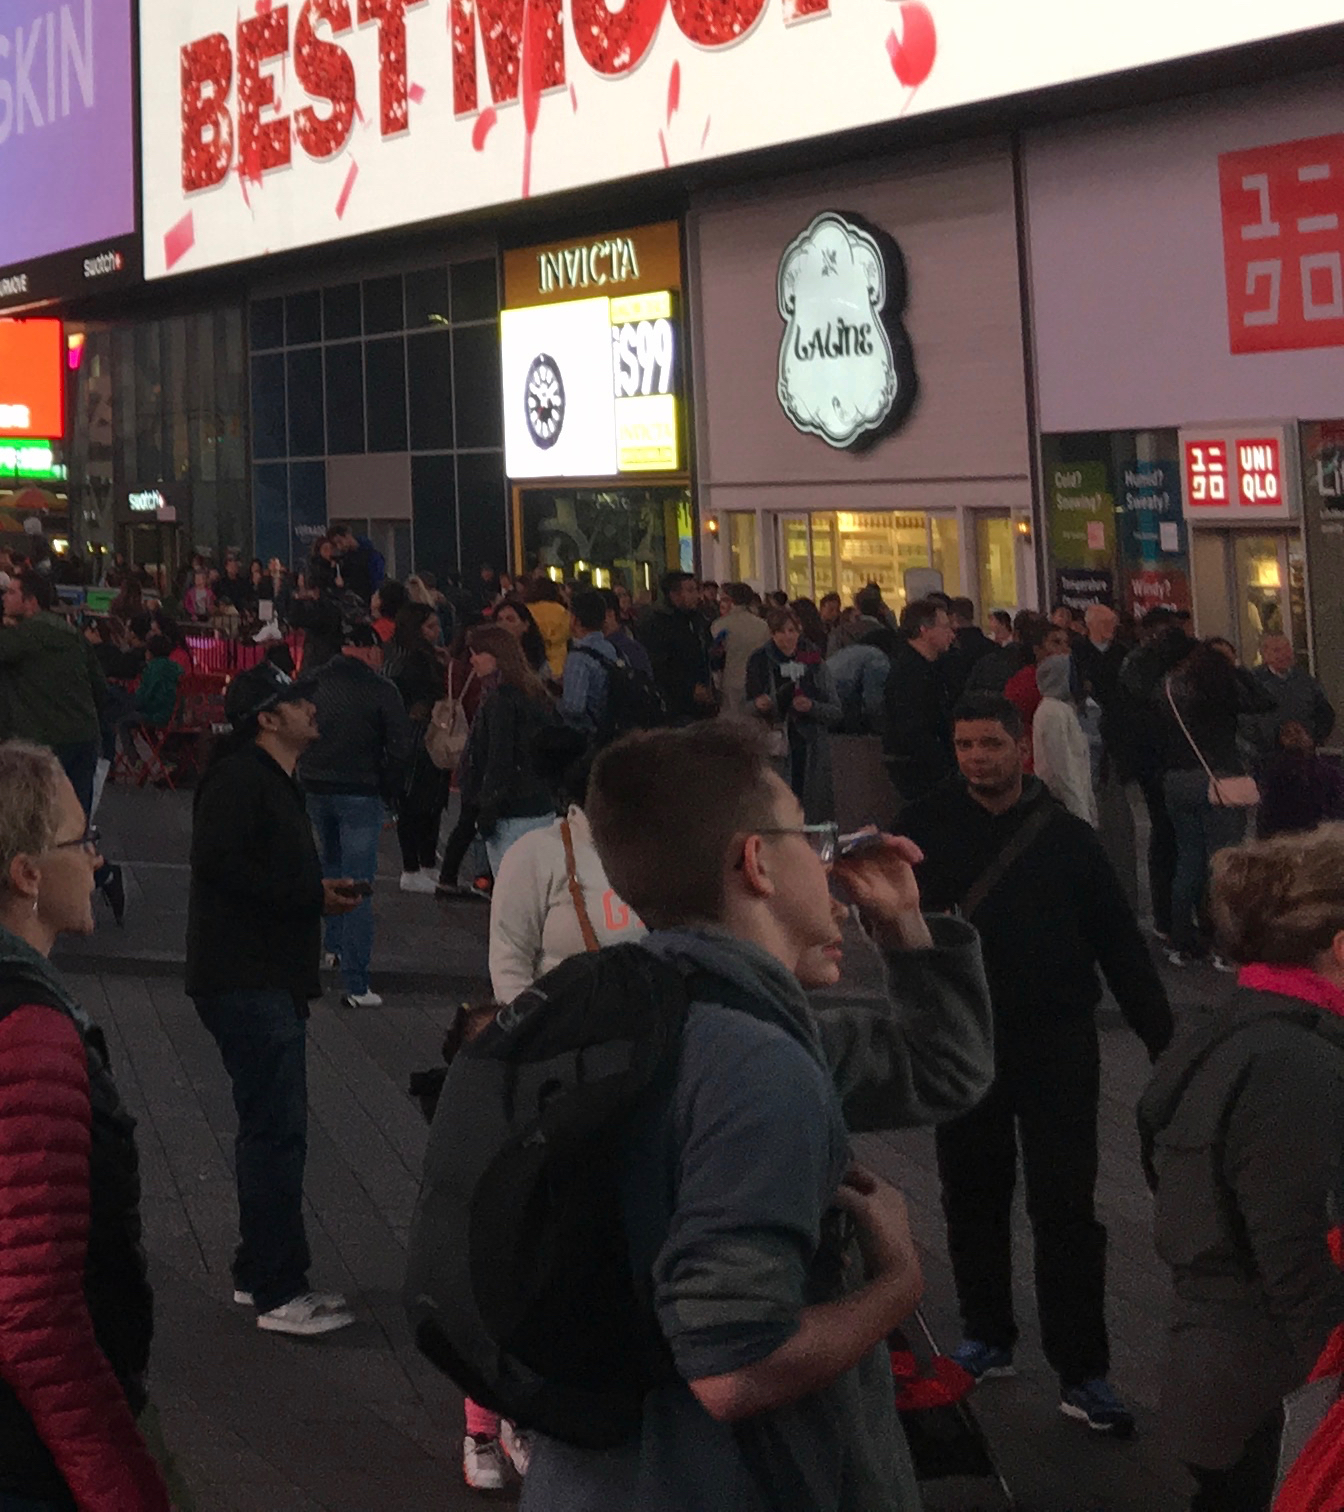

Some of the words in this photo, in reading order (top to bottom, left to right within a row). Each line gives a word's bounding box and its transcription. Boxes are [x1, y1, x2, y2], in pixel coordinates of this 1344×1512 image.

[83, 249, 116, 278] swatch
[537, 237, 641, 294] INVICTA
[1239, 445, 1273, 472] UNI
[1241, 472, 1277, 503] QLO
